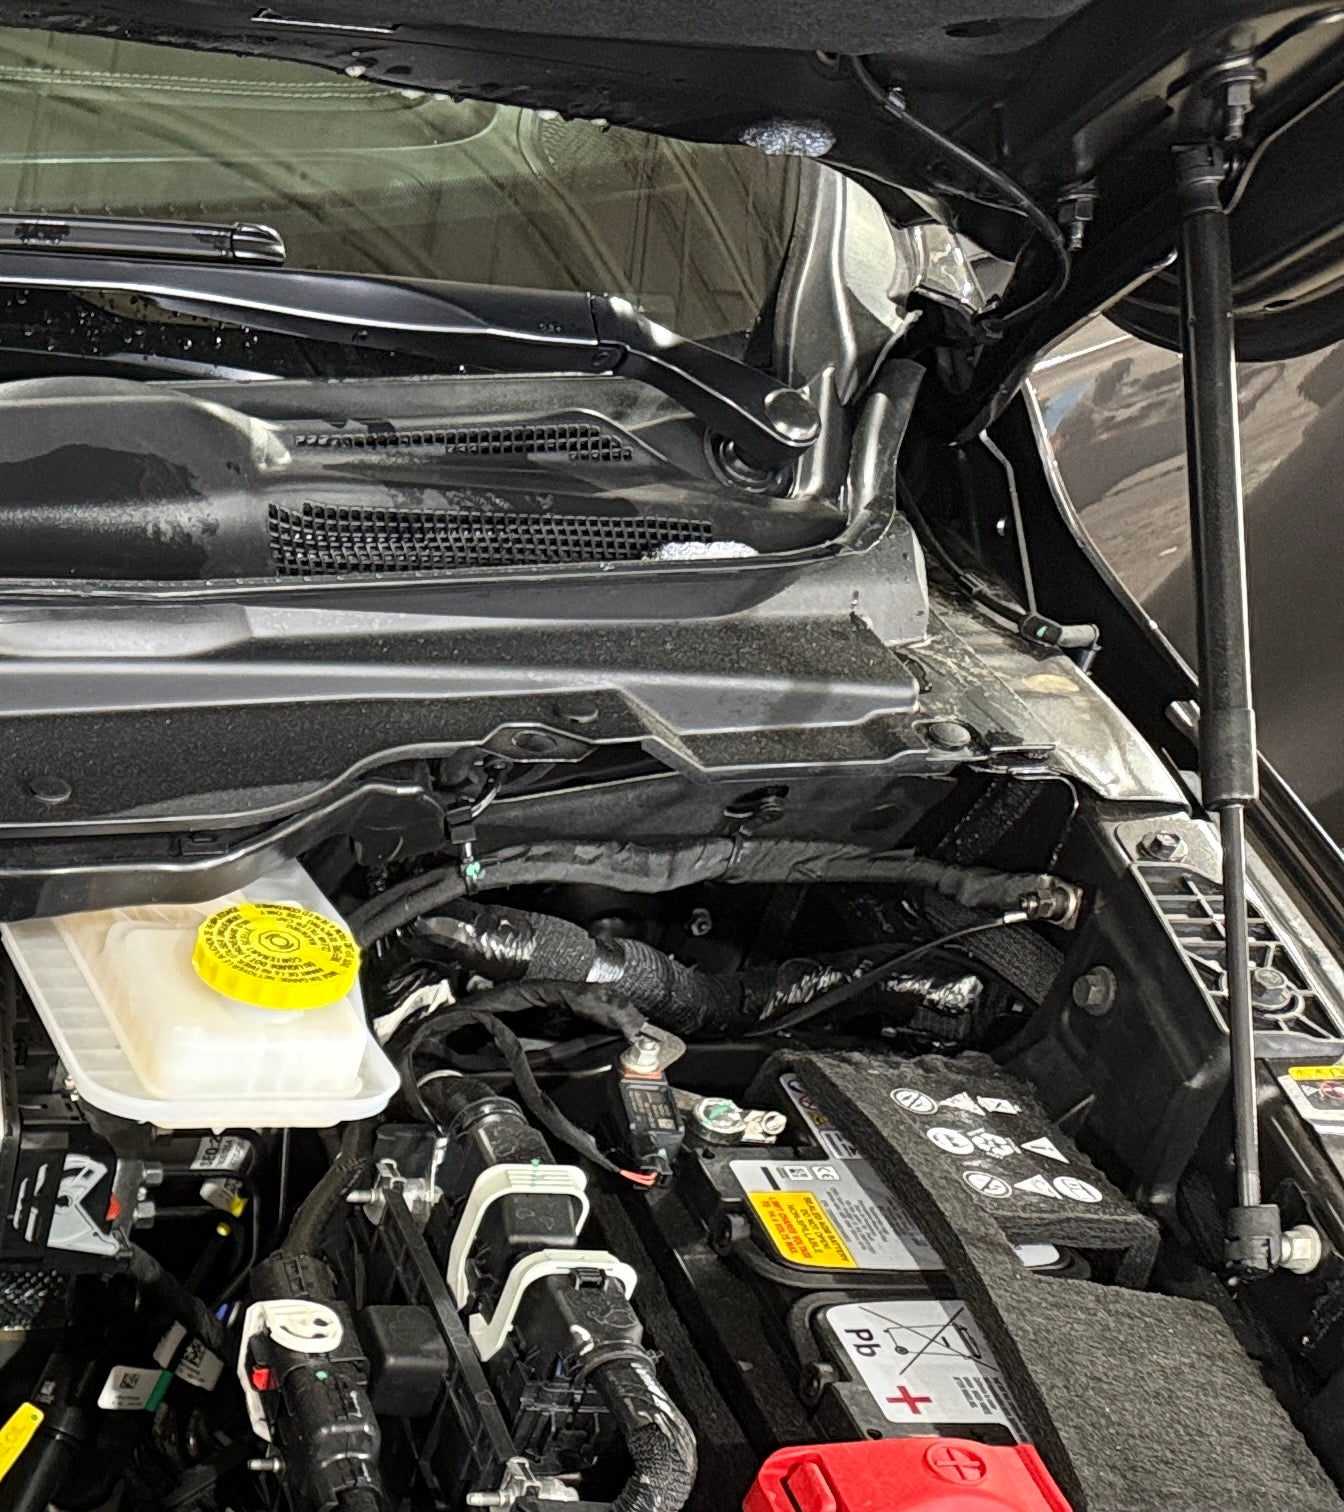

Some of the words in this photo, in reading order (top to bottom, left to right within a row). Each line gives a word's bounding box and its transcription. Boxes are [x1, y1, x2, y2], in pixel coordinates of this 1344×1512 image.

[803, 1197, 822, 1220] SEALED
[827, 1235, 850, 1262] BATTERY
[808, 1218, 819, 1230] NOT
[844, 1328, 882, 1358] Pb
